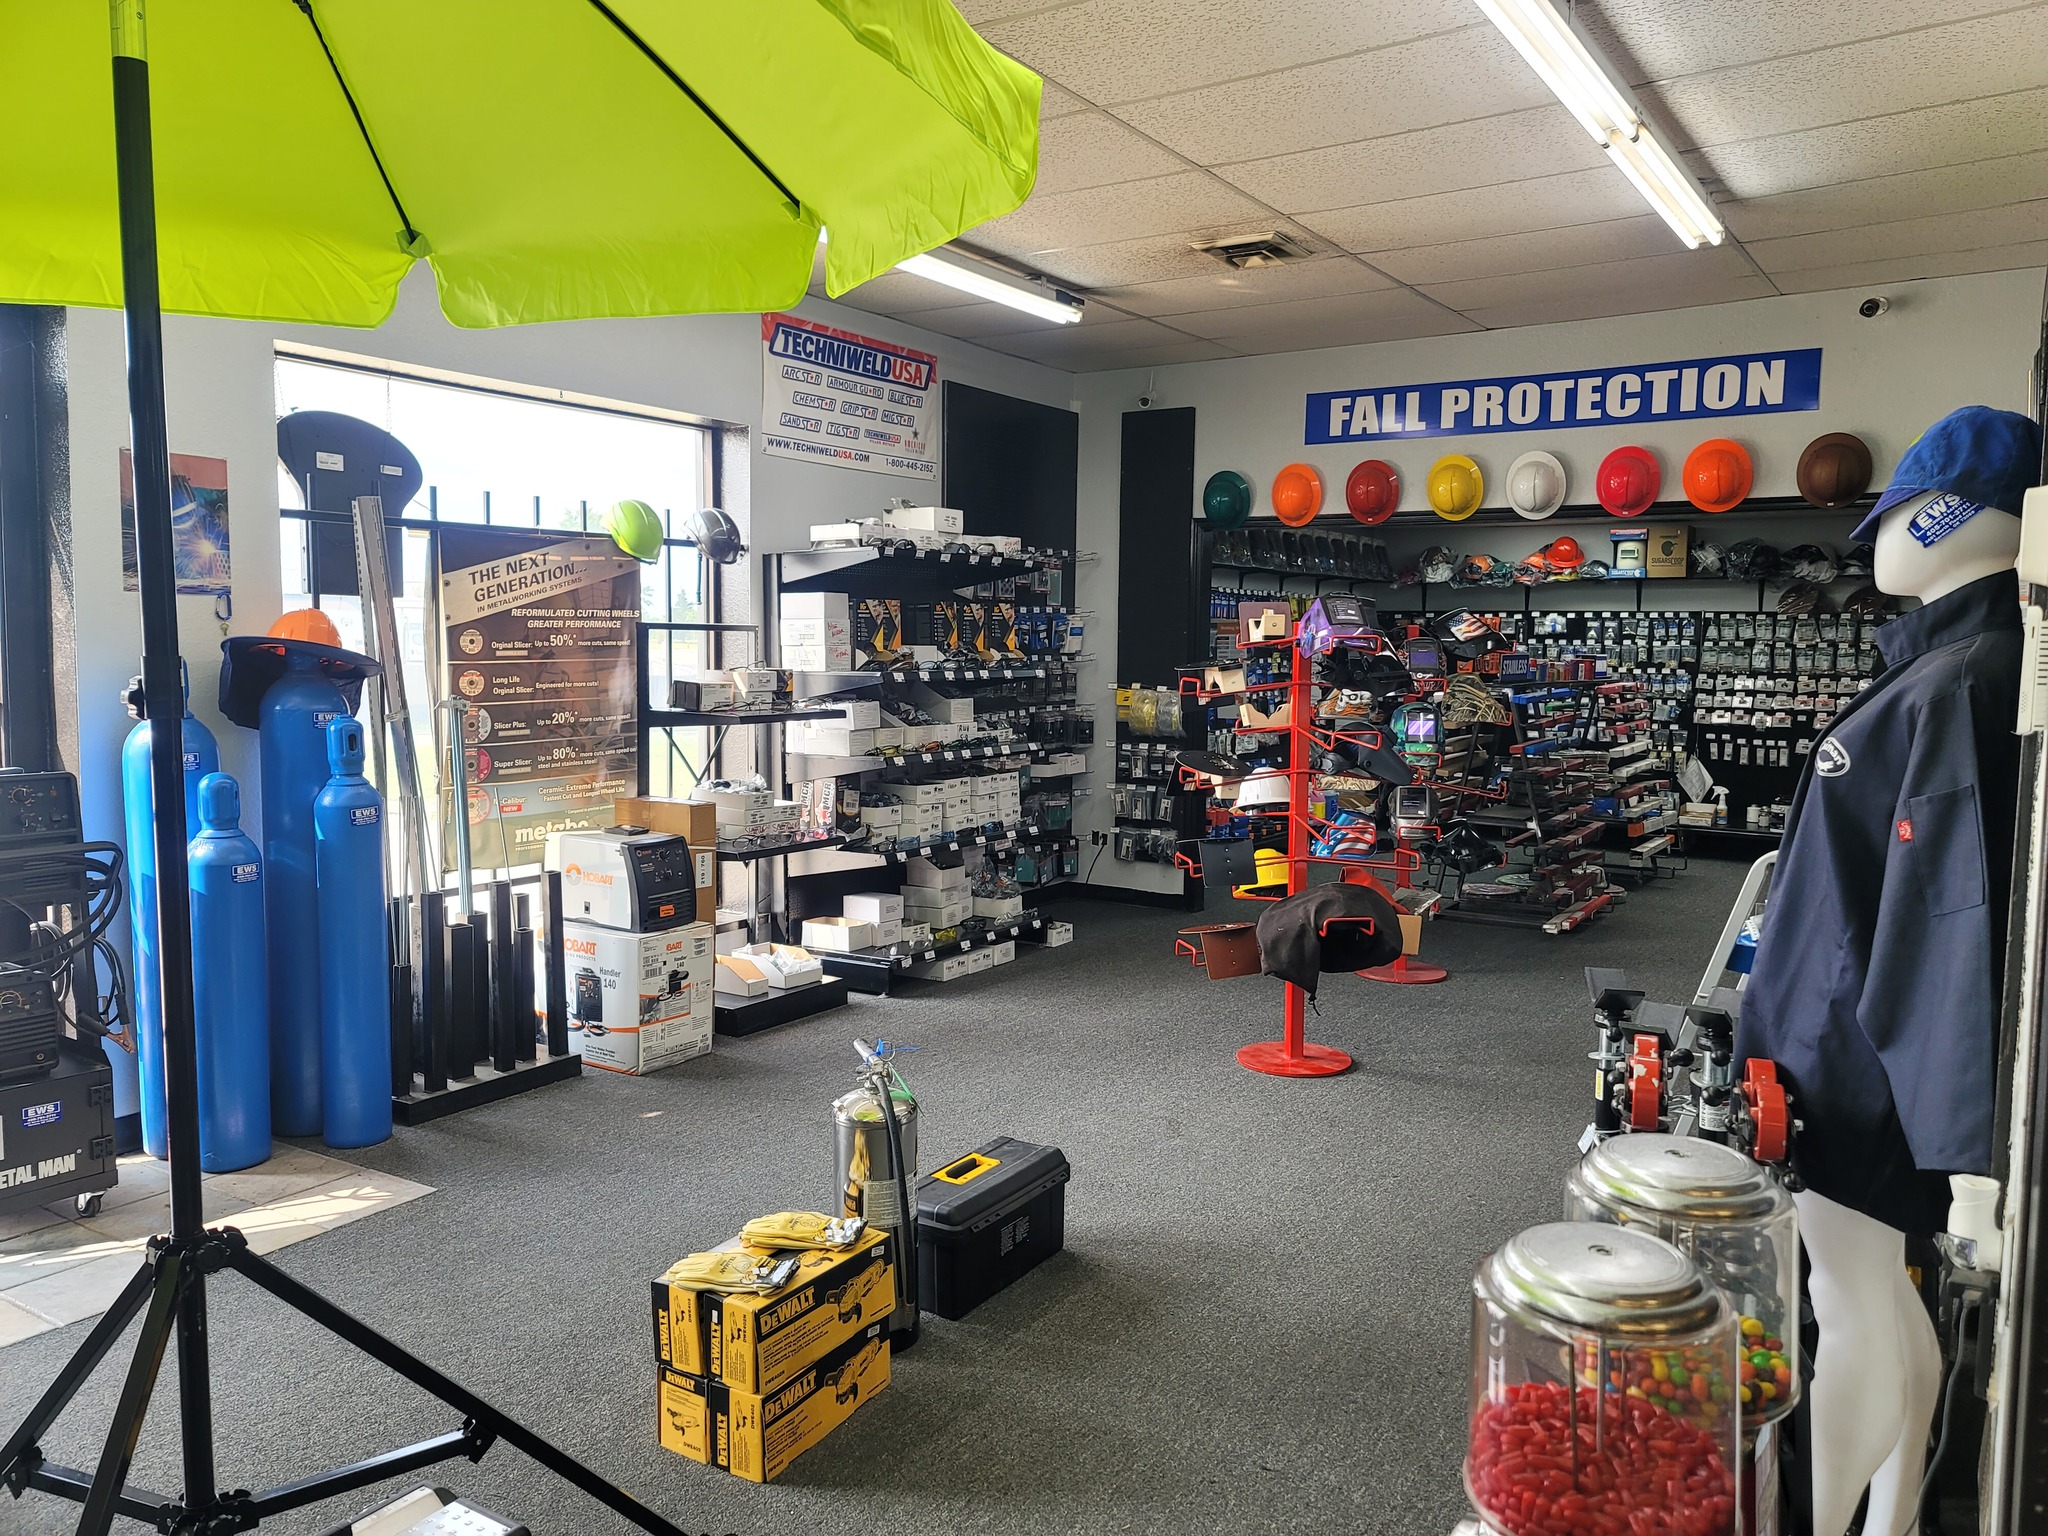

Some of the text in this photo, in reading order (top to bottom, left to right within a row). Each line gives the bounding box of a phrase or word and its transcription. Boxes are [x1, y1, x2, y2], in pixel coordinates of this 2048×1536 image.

[781, 328, 923, 386] TECHNIWELDUSA
[1328, 359, 1786, 437] FALL PROTECTION
[767, 437, 870, 463] WWW.TECHNIWELDUSA.COM
[885, 458, 934, 473] 1-800-445-2152
[1914, 493, 1960, 528] EWS
[1926, 502, 1971, 536] 405-701-3711
[468, 552, 549, 585] THE NEXT
[474, 562, 587, 602] GENERATION...
[487, 587, 548, 610] METALWORKING
[549, 577, 583, 591] SYSTEMS
[511, 609, 575, 617] REFORMULATED
[577, 609, 611, 617] CUTTING
[527, 620, 621, 628] GREATER PERFORMANCE
[1503, 659, 1527, 674] STAINLESS
[494, 760, 514, 769] Super
[515, 758, 533, 766] Slicer:
[538, 779, 625, 794] Ceramic: Extreme Performance
[356, 808, 376, 817] EWS
[237, 864, 257, 874] EWS
[583, 871, 613, 886] HOBART
[563, 938, 597, 956] OBART
[600, 966, 621, 978] Handler
[603, 978, 616, 989] 140
[28, 1104, 55, 1117] EWS
[0, 1153, 75, 1190] ETAL MAN
